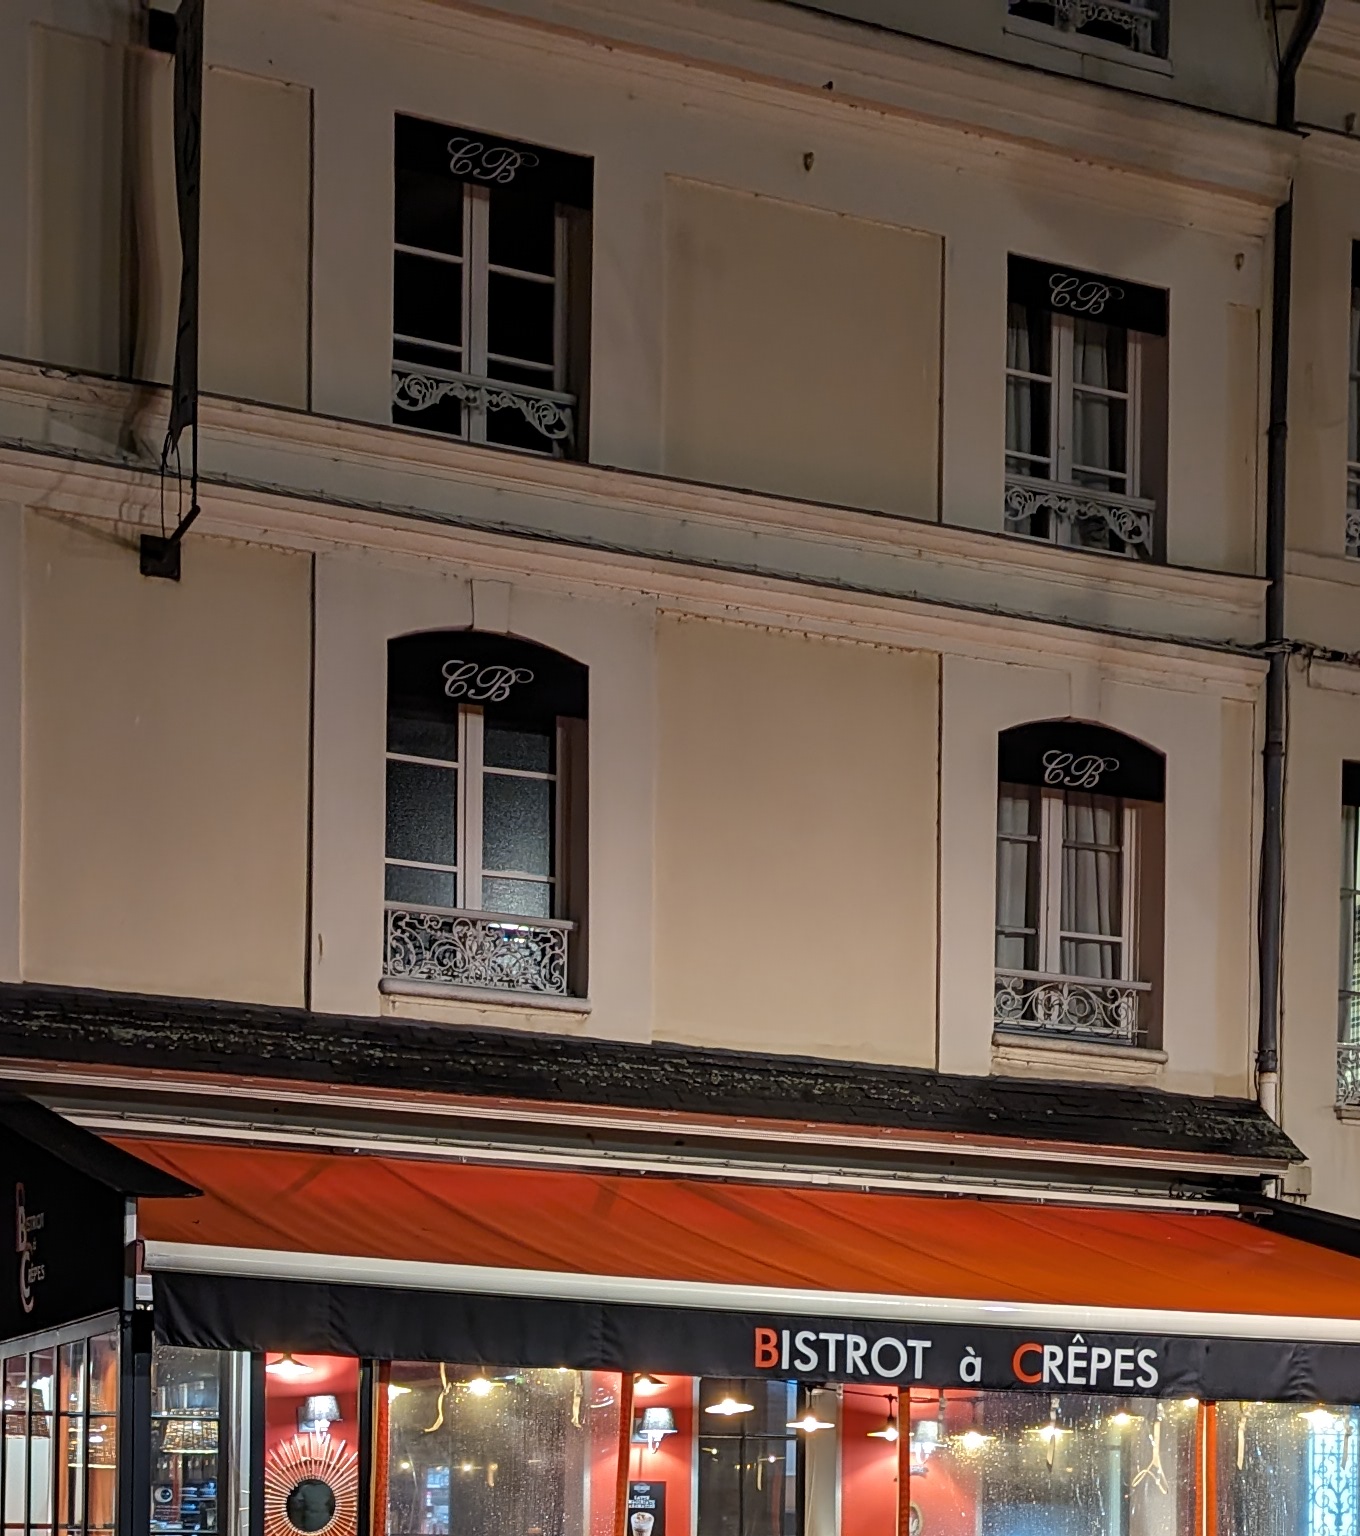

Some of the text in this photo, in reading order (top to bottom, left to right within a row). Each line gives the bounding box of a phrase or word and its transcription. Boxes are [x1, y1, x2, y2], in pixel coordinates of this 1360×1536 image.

[754, 1327, 1159, 1389] BISTROT à CRÊPES
